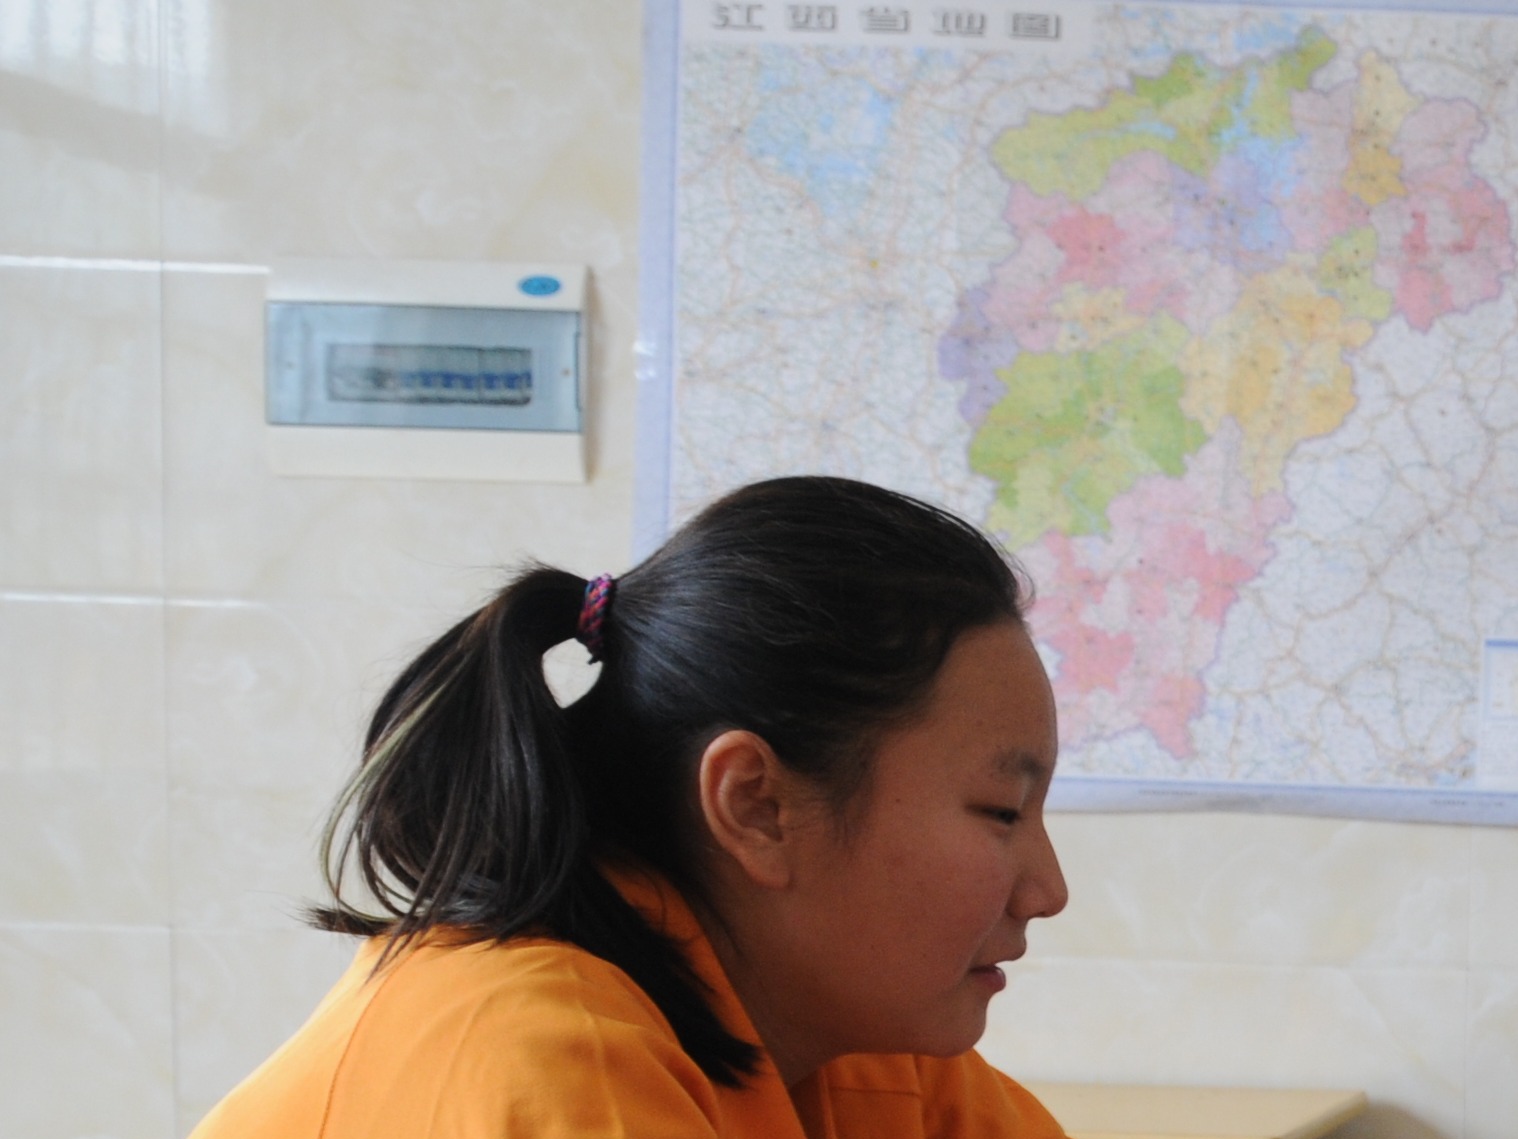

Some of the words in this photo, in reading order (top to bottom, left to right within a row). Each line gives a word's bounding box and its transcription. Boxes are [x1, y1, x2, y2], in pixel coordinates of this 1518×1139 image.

[710, 3, 1062, 41] 江西省地图
